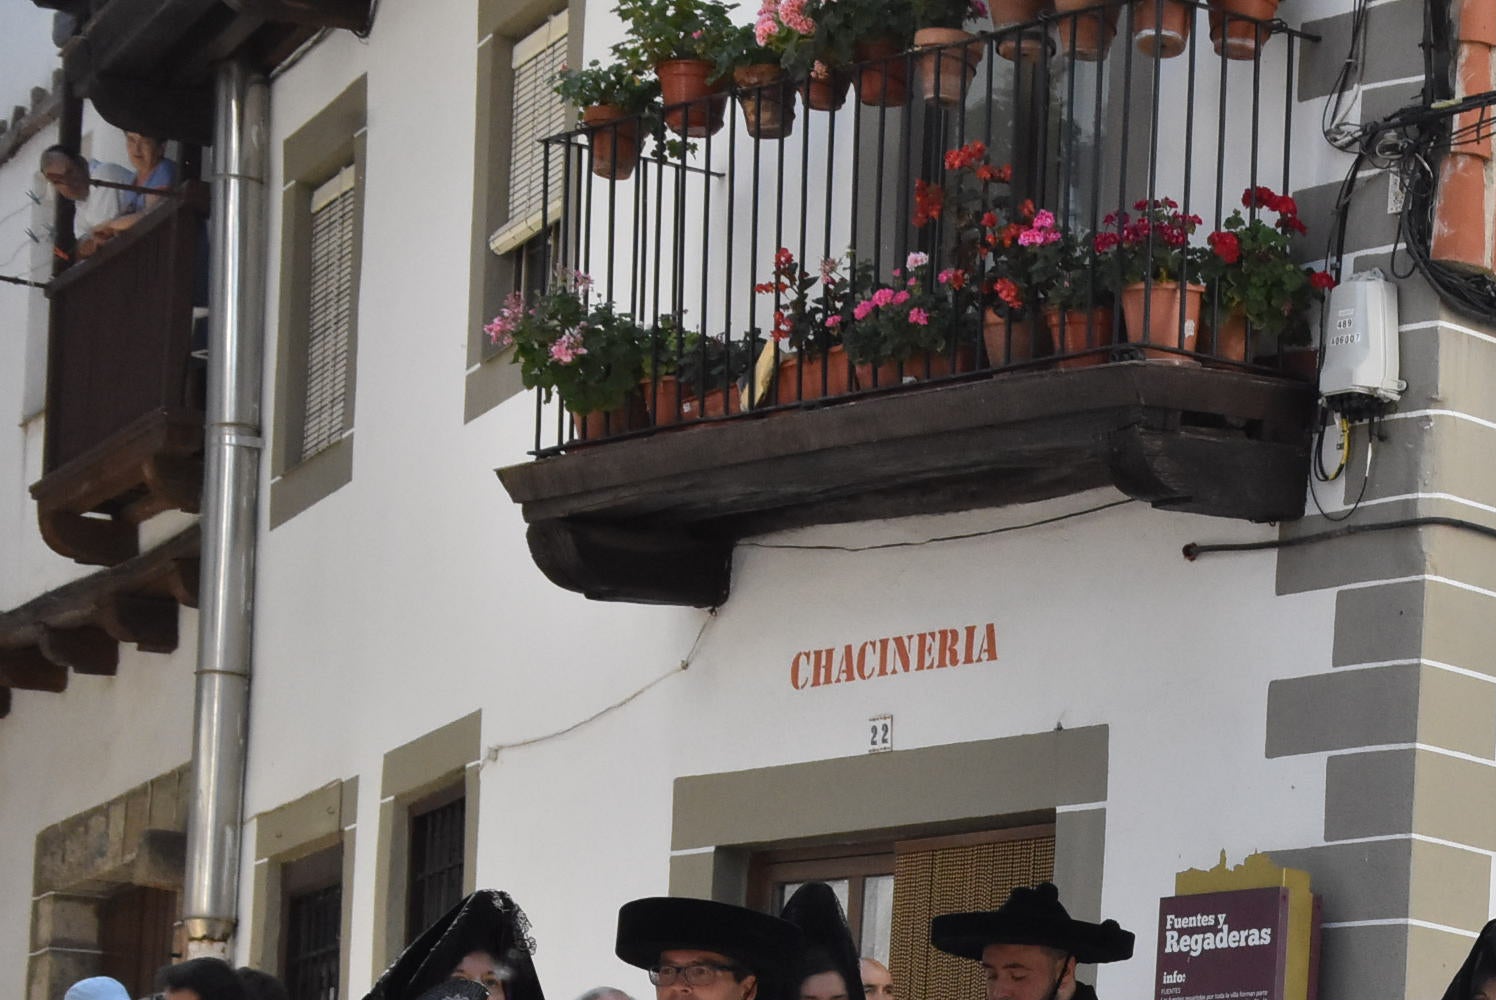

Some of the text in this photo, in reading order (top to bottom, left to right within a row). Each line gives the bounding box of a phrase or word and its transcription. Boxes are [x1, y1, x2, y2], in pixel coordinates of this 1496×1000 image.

[790, 623, 998, 690] CHACINERIA
[870, 723, 889, 745] 22
[1166, 913, 1226, 929] Fuentes y
[1164, 924, 1272, 957] Regaderas
[1162, 970, 1186, 984] info:
